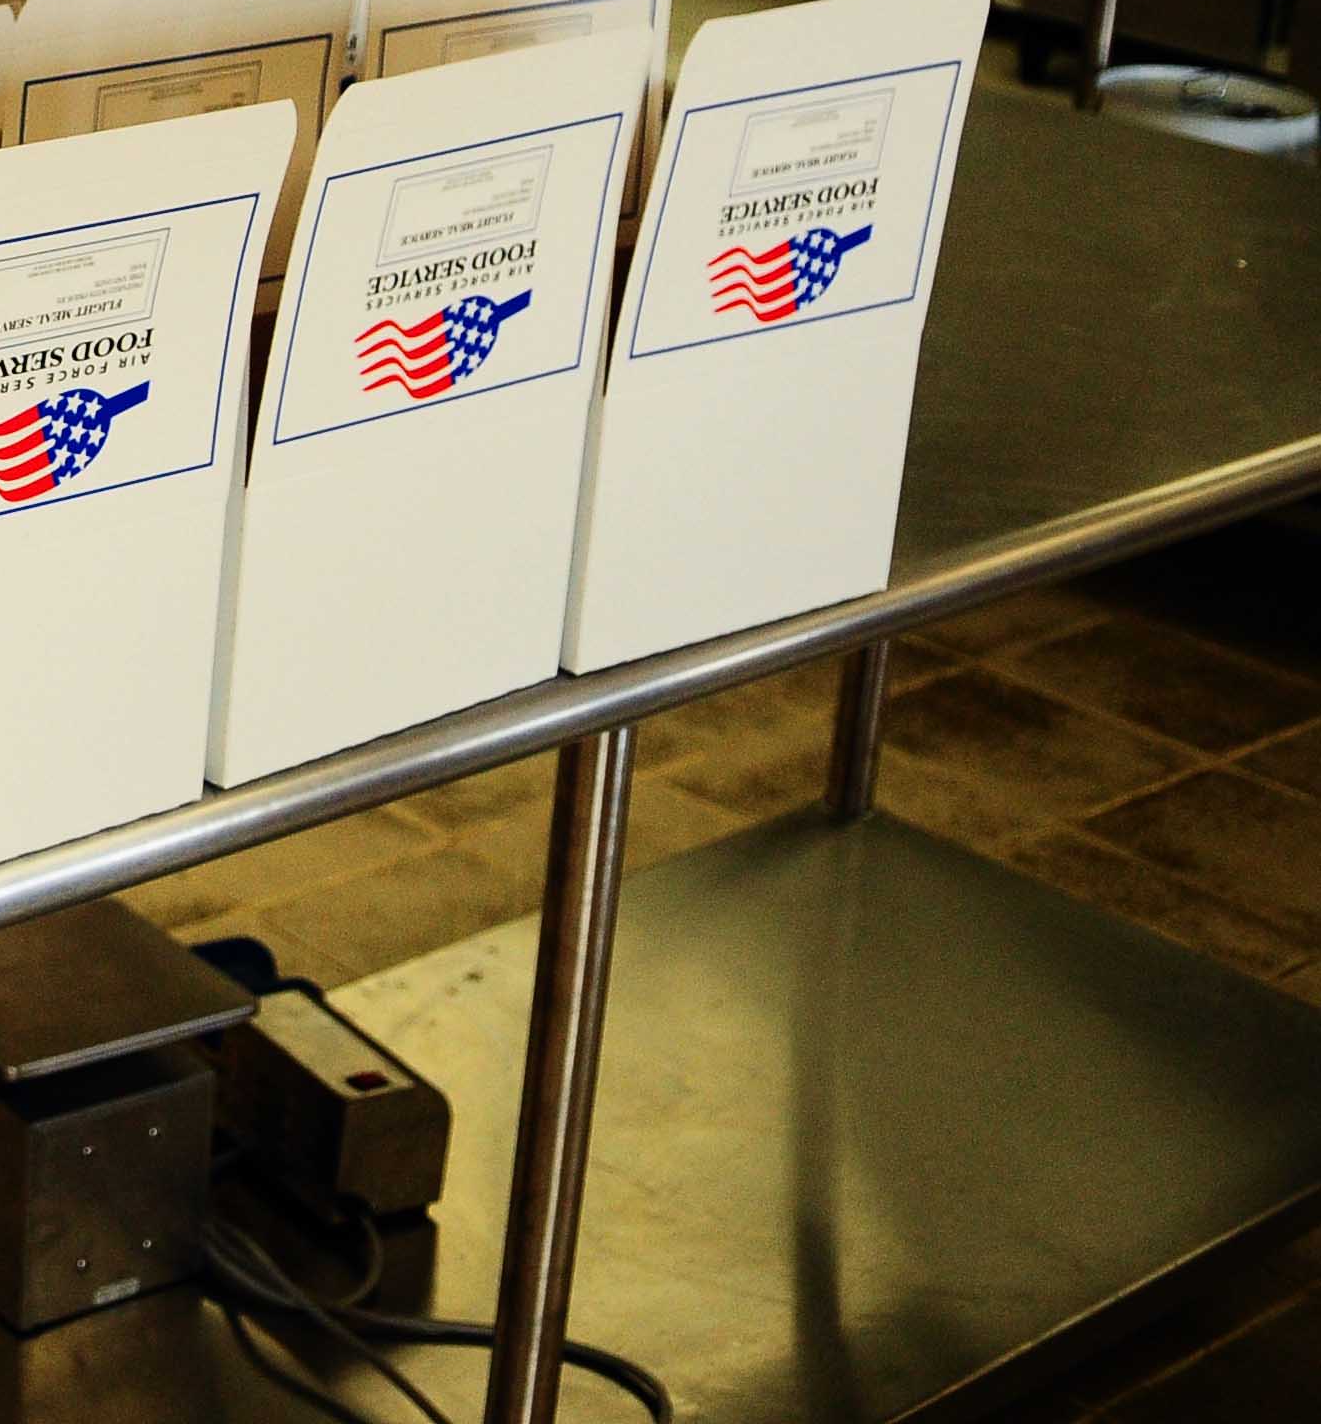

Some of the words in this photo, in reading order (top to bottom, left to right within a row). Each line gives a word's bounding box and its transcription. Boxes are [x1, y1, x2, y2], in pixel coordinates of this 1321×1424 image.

[819, 179, 877, 202] FOOD
[722, 192, 812, 222] SERVICE
[473, 241, 535, 269] FOOD
[369, 258, 466, 295] SERVICE
[451, 270, 499, 290] FORCE
[508, 262, 532, 276] AIR
[76, 298, 121, 316] FLIGHT
[365, 284, 442, 311] SERVICES
[36, 308, 72, 324] MEAL
[73, 329, 152, 360] FOOD
[120, 353, 149, 367] AIR
[48, 362, 107, 383] FORCE
